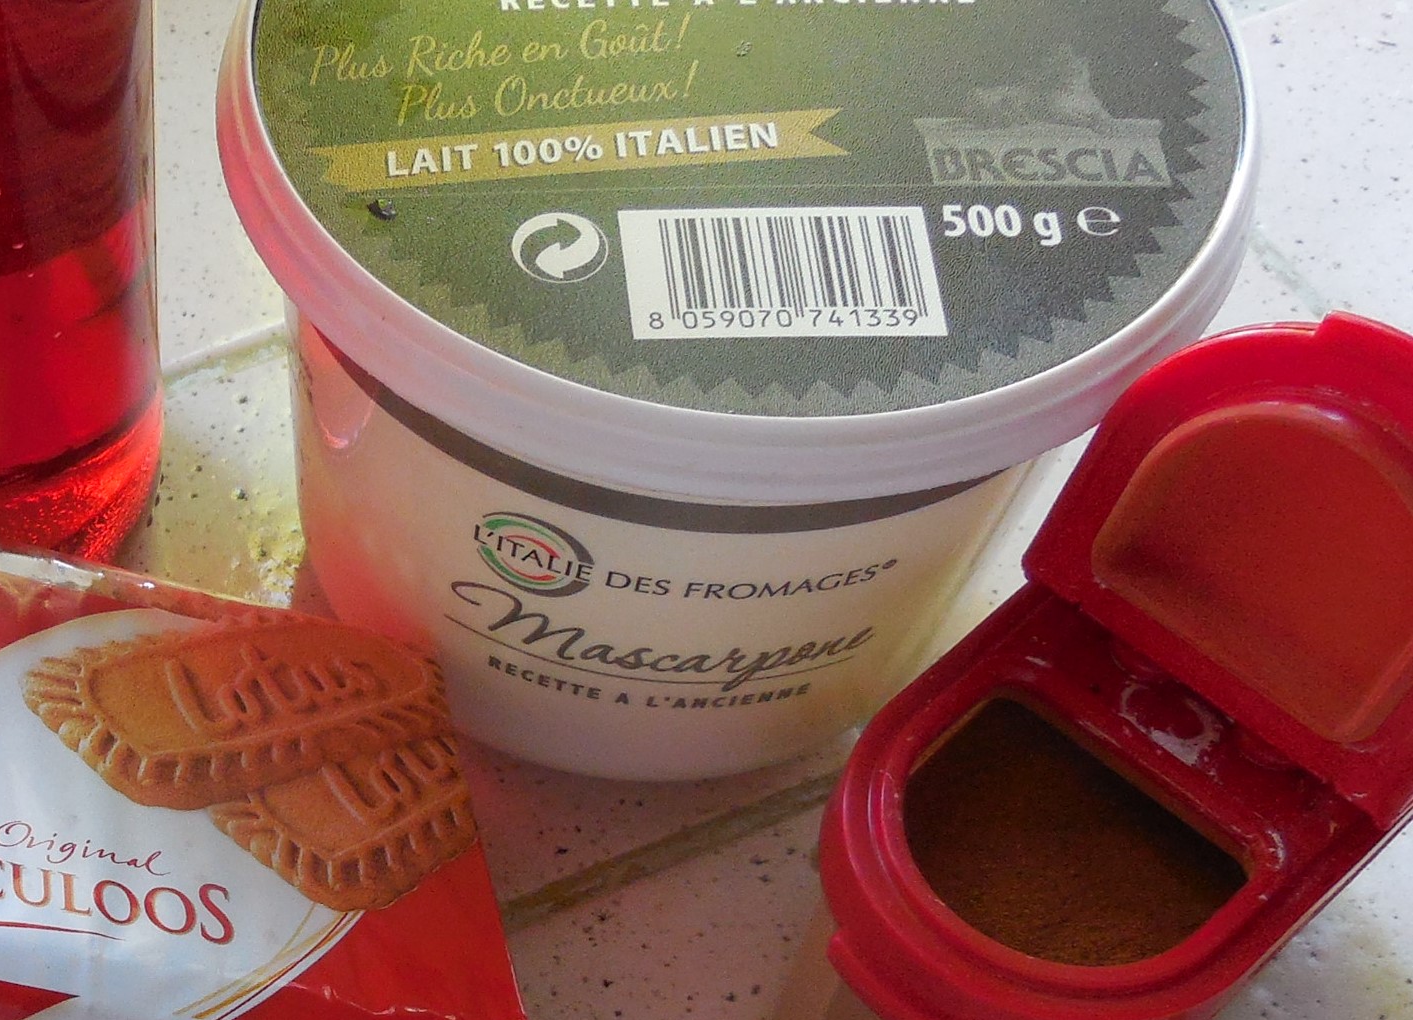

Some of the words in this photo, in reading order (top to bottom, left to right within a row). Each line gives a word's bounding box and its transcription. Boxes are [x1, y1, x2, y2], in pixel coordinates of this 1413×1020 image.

[309, 45, 391, 87] Plus
[406, 30, 511, 79] Riche
[522, 42, 568, 64] en
[397, 84, 479, 127] Plus
[386, 143, 479, 178] LAIT
[493, 136, 603, 169] 100%
[614, 121, 779, 159] ITALIEN
[936, 147, 1163, 183] BRESCIA
[942, 204, 1022, 237] 500
[1033, 211, 1063, 247] g
[649, 311, 665, 330] 8
[682, 310, 793, 330] 059070
[809, 309, 919, 328] 741339
[472, 523, 593, 582] L'ITALIE
[605, 571, 670, 597] DES
[451, 580, 874, 693] Mascarpone
[489, 656, 602, 699] RECETTE
[646, 683, 810, 709] L'ANCIENNE
